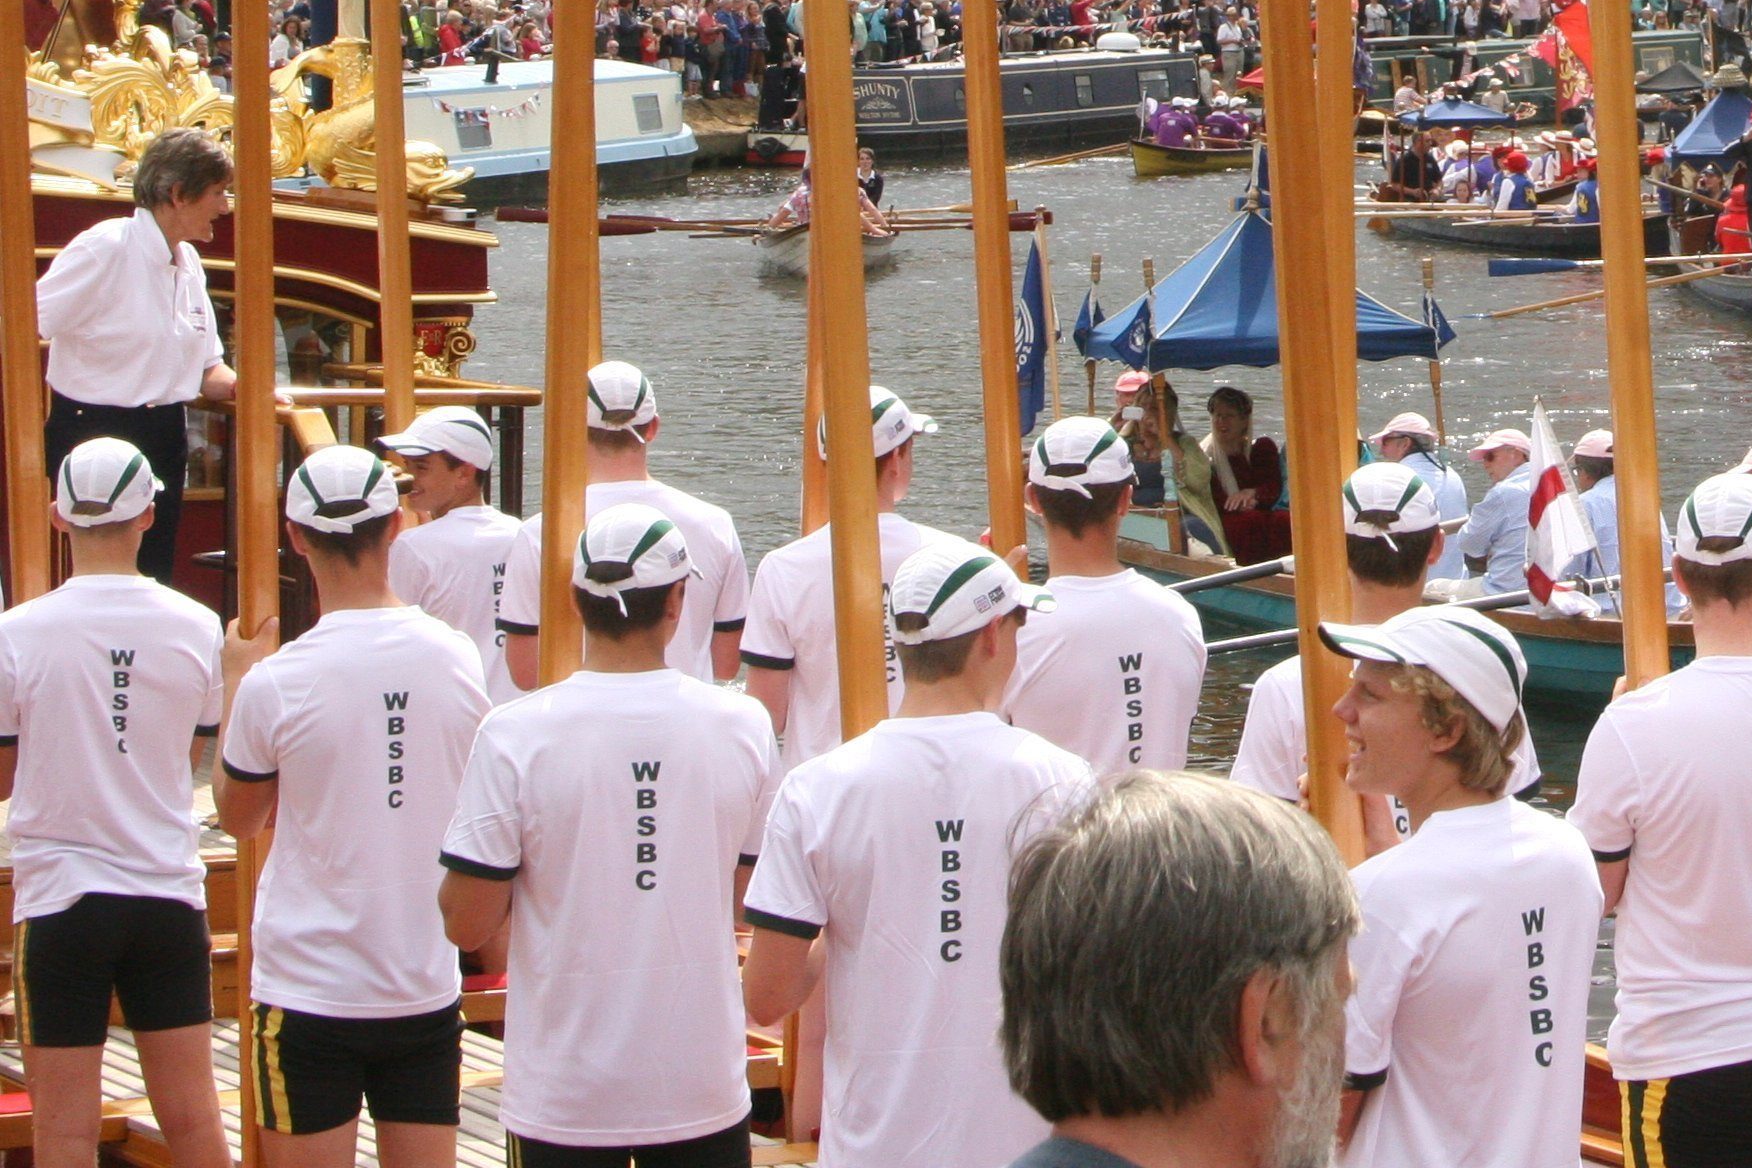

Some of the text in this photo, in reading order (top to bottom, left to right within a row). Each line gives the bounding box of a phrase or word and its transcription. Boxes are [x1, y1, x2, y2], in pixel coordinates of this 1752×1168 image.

[852, 82, 901, 100] SHUNTY
[383, 691, 409, 809] WBSBC
[1118, 652, 1143, 764] WBSBC
[631, 761, 661, 891] WBSBC
[935, 819, 964, 963] WBSBC
[1521, 907, 1554, 1067] WBSBC
